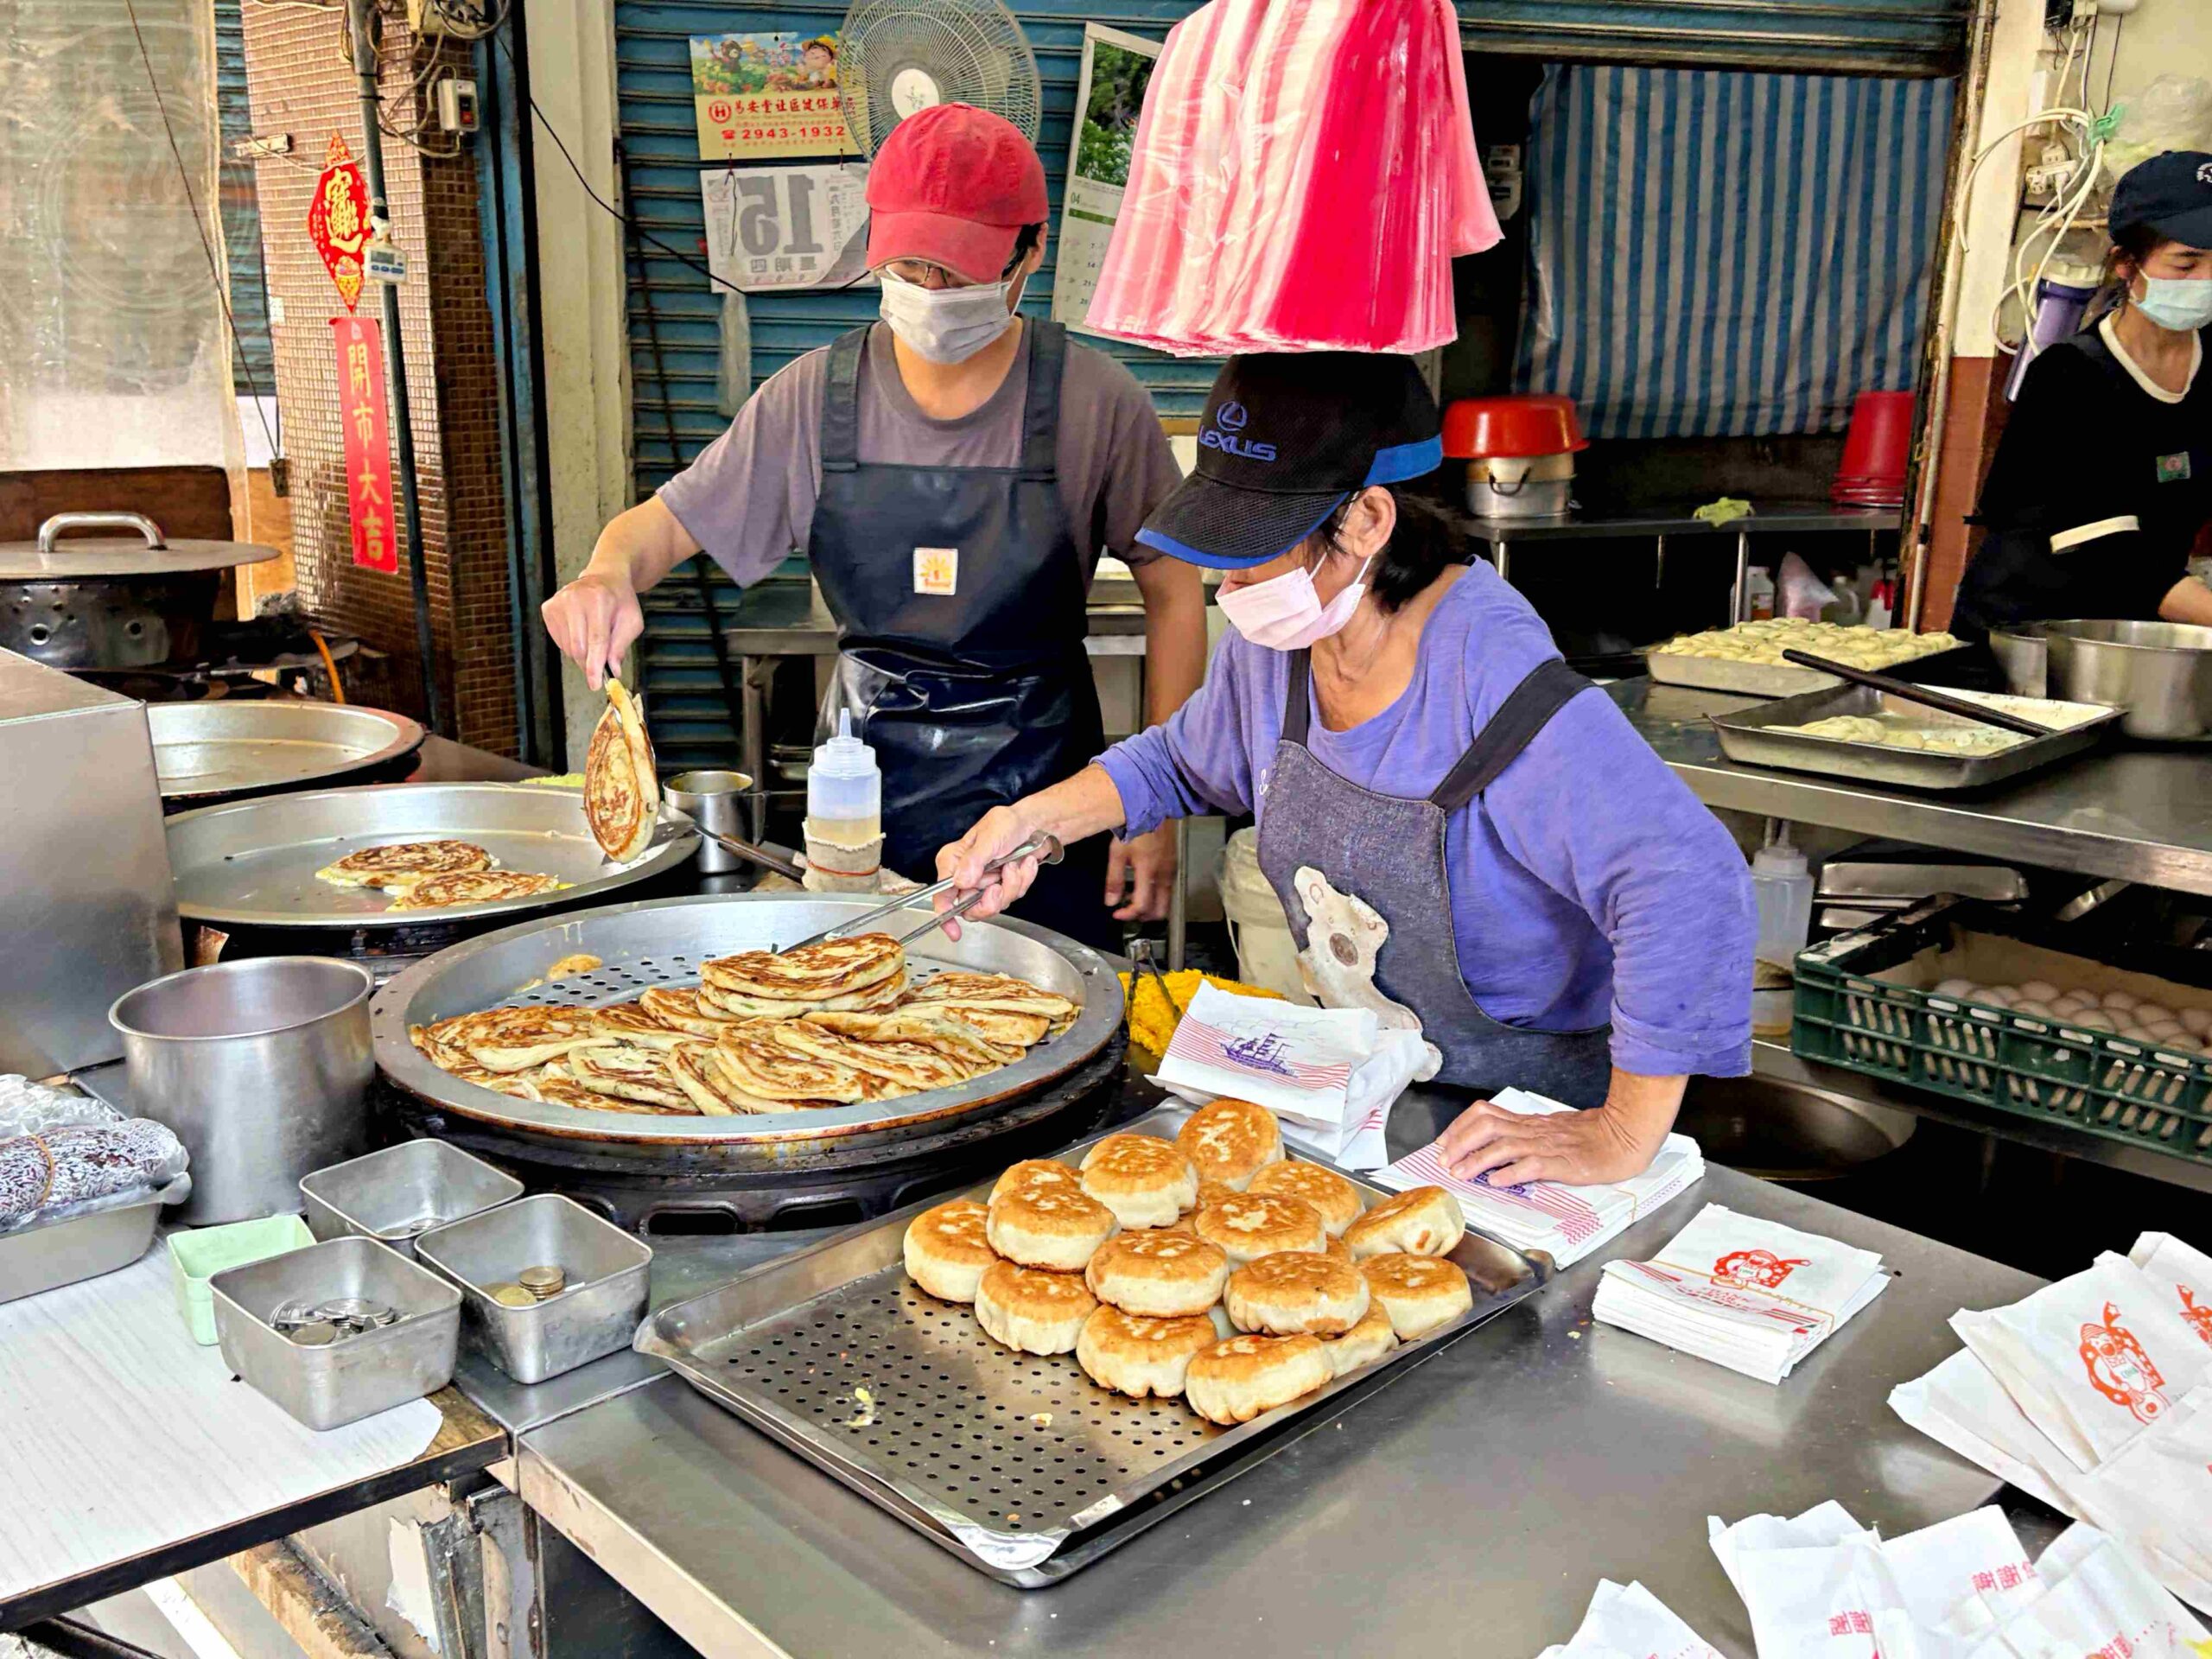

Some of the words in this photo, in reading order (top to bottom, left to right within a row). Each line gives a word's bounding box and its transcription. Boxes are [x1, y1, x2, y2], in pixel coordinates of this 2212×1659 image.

[741, 125, 845, 139] 2943-1932
[347, 342, 384, 560] 開市大吉
